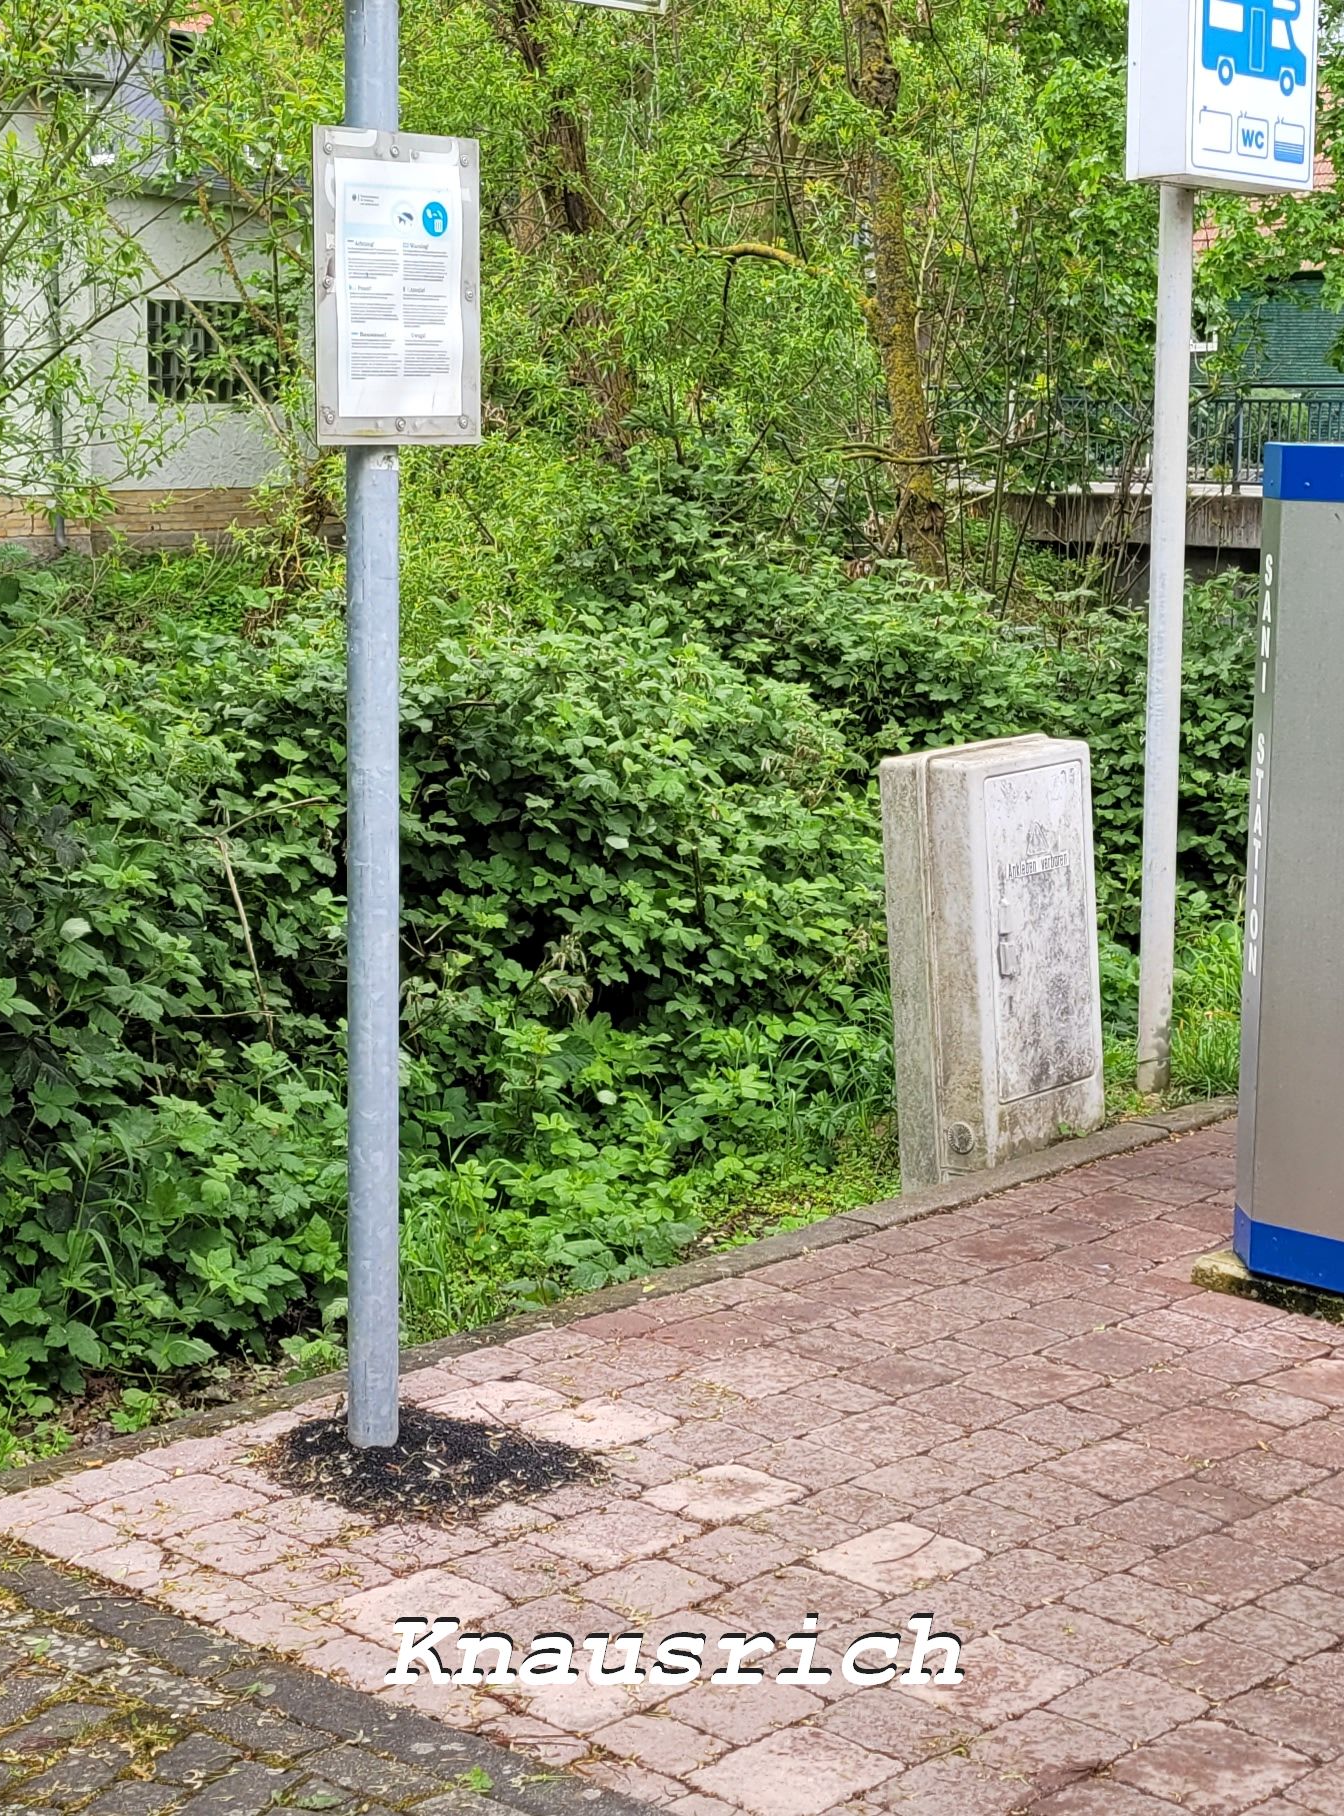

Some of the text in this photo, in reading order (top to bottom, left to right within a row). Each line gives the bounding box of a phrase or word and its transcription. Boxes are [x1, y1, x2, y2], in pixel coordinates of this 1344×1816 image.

[1242, 128, 1265, 150] WC
[1248, 554, 1273, 977] SANI STATION
